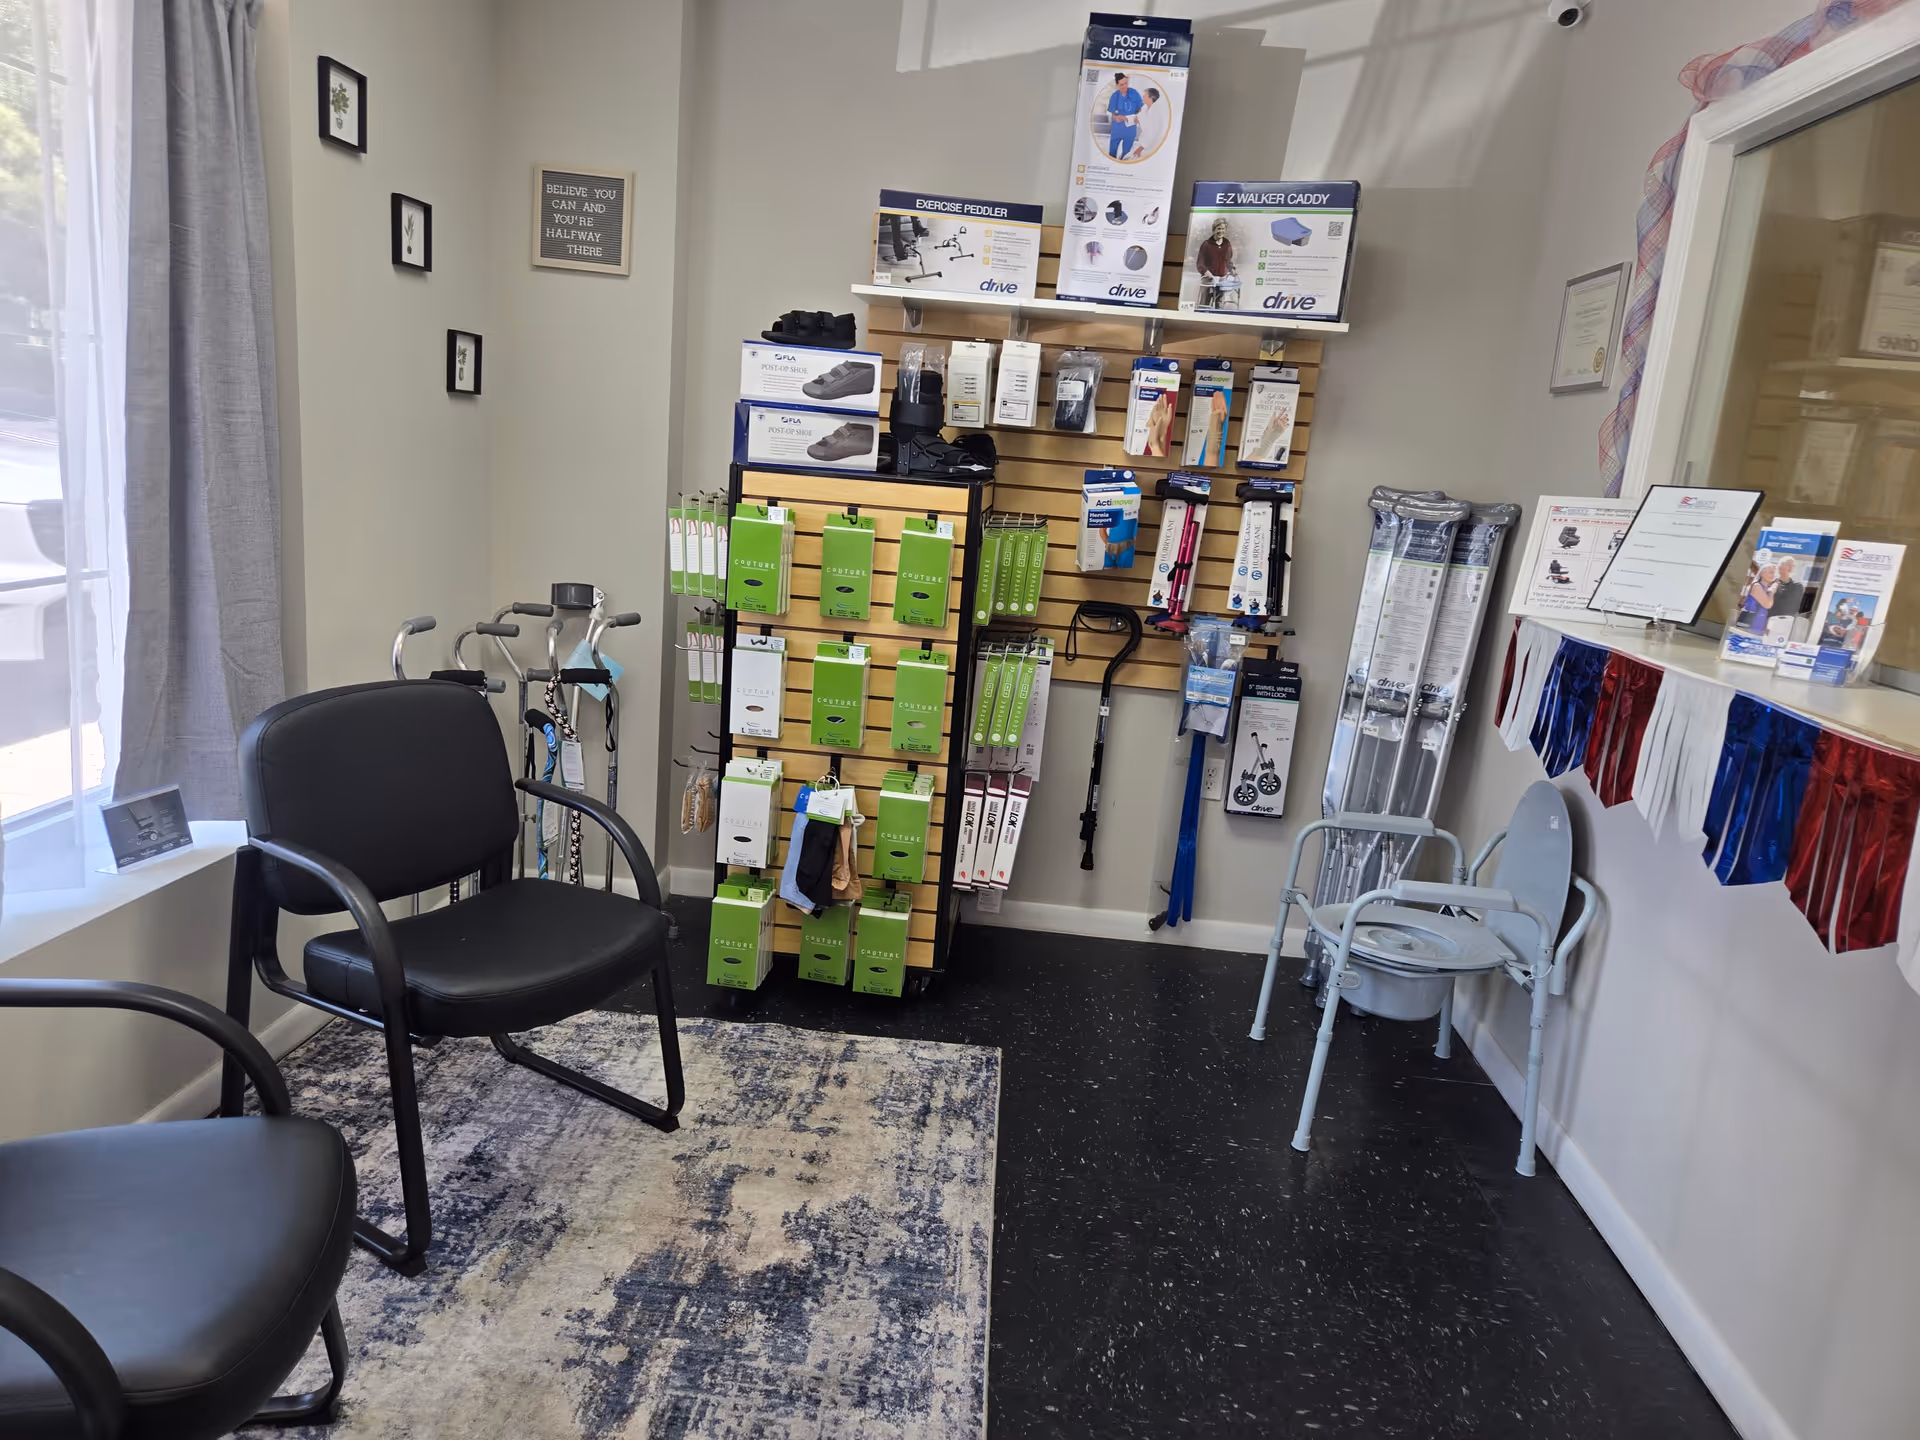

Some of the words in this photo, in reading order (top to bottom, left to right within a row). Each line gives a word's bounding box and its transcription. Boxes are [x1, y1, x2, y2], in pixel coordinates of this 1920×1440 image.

[1113, 34, 1145, 48] POST
[1146, 38, 1166, 49] HIP
[1100, 47, 1156, 60] SURGERY
[1158, 52, 1176, 64] KIT
[546, 184, 588, 197] BELIEVE
[594, 189, 616, 200] YOU
[1216, 193, 1235, 204] E-Z
[1237, 193, 1286, 204] WALKER
[1287, 194, 1330, 204] CADDY
[552, 200, 576, 210] CAN
[583, 202, 606, 213] AND
[916, 199, 962, 213] EXERCISE
[964, 204, 1008, 218] PEDDLER
[554, 214, 594, 226] YOU'RE
[546, 228, 601, 242] HALFWAY
[567, 245, 602, 256] THERE
[980, 278, 1018, 294] drive
[1108, 284, 1146, 298] drive
[1263, 292, 1316, 310] drive
[761, 364, 789, 372] POST-OP
[1144, 376, 1176, 384] Acti
[768, 426, 794, 435] POST-OP
[1160, 520, 1175, 566] HURRYCANE
[1252, 524, 1262, 570] HURRYCANE
[735, 559, 775, 569] COUTURE
[827, 567, 865, 576] COUTURE
[982, 560, 990, 592] COUTURE
[902, 572, 942, 583] COUTURE
[1377, 678, 1405, 689] drive
[1422, 682, 1448, 694] drive
[817, 698, 857, 706] COUTURE
[899, 702, 938, 711] COUTURE
[1252, 804, 1274, 813] drive
[881, 832, 920, 842] COUTURE
[715, 938, 753, 949] COUTURE
[806, 935, 842, 945] COUTURE
[861, 948, 900, 959] COUTURE
